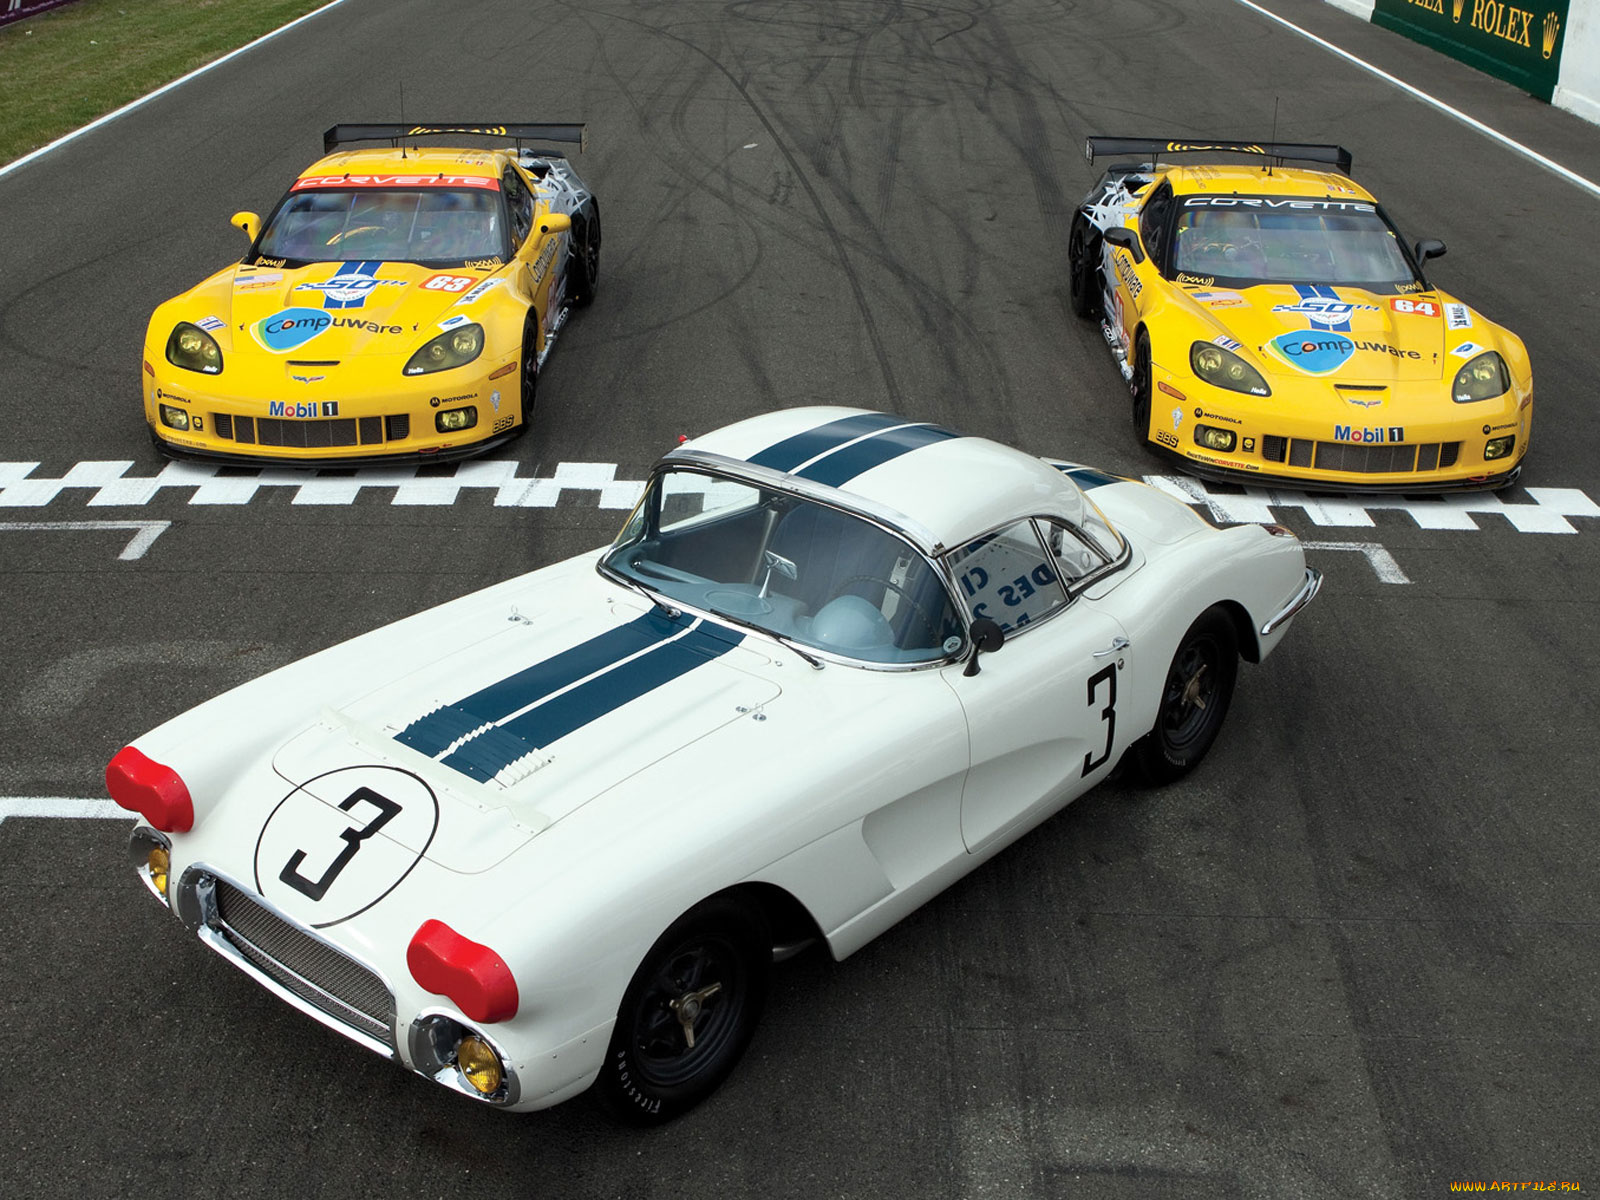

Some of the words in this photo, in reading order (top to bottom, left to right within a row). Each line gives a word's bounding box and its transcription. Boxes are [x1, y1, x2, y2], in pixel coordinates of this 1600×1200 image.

[1471, 0, 1534, 48] ROLEX
[298, 174, 490, 188] CORVETTE
[1184, 197, 1376, 213] CORVETTE
[425, 275, 472, 292] 63
[1394, 299, 1435, 316] 64
[266, 316, 403, 334] Compuware
[1283, 340, 1422, 360] Compuware
[441, 392, 478, 404] MOTOROLA
[269, 401, 317, 418] Mobil
[1203, 412, 1242, 425] MOTOROLA
[1334, 425, 1384, 443] Mobil
[1081, 662, 1117, 779] 3
[279, 786, 403, 902] 3
[617, 1050, 661, 1114] Firestone
